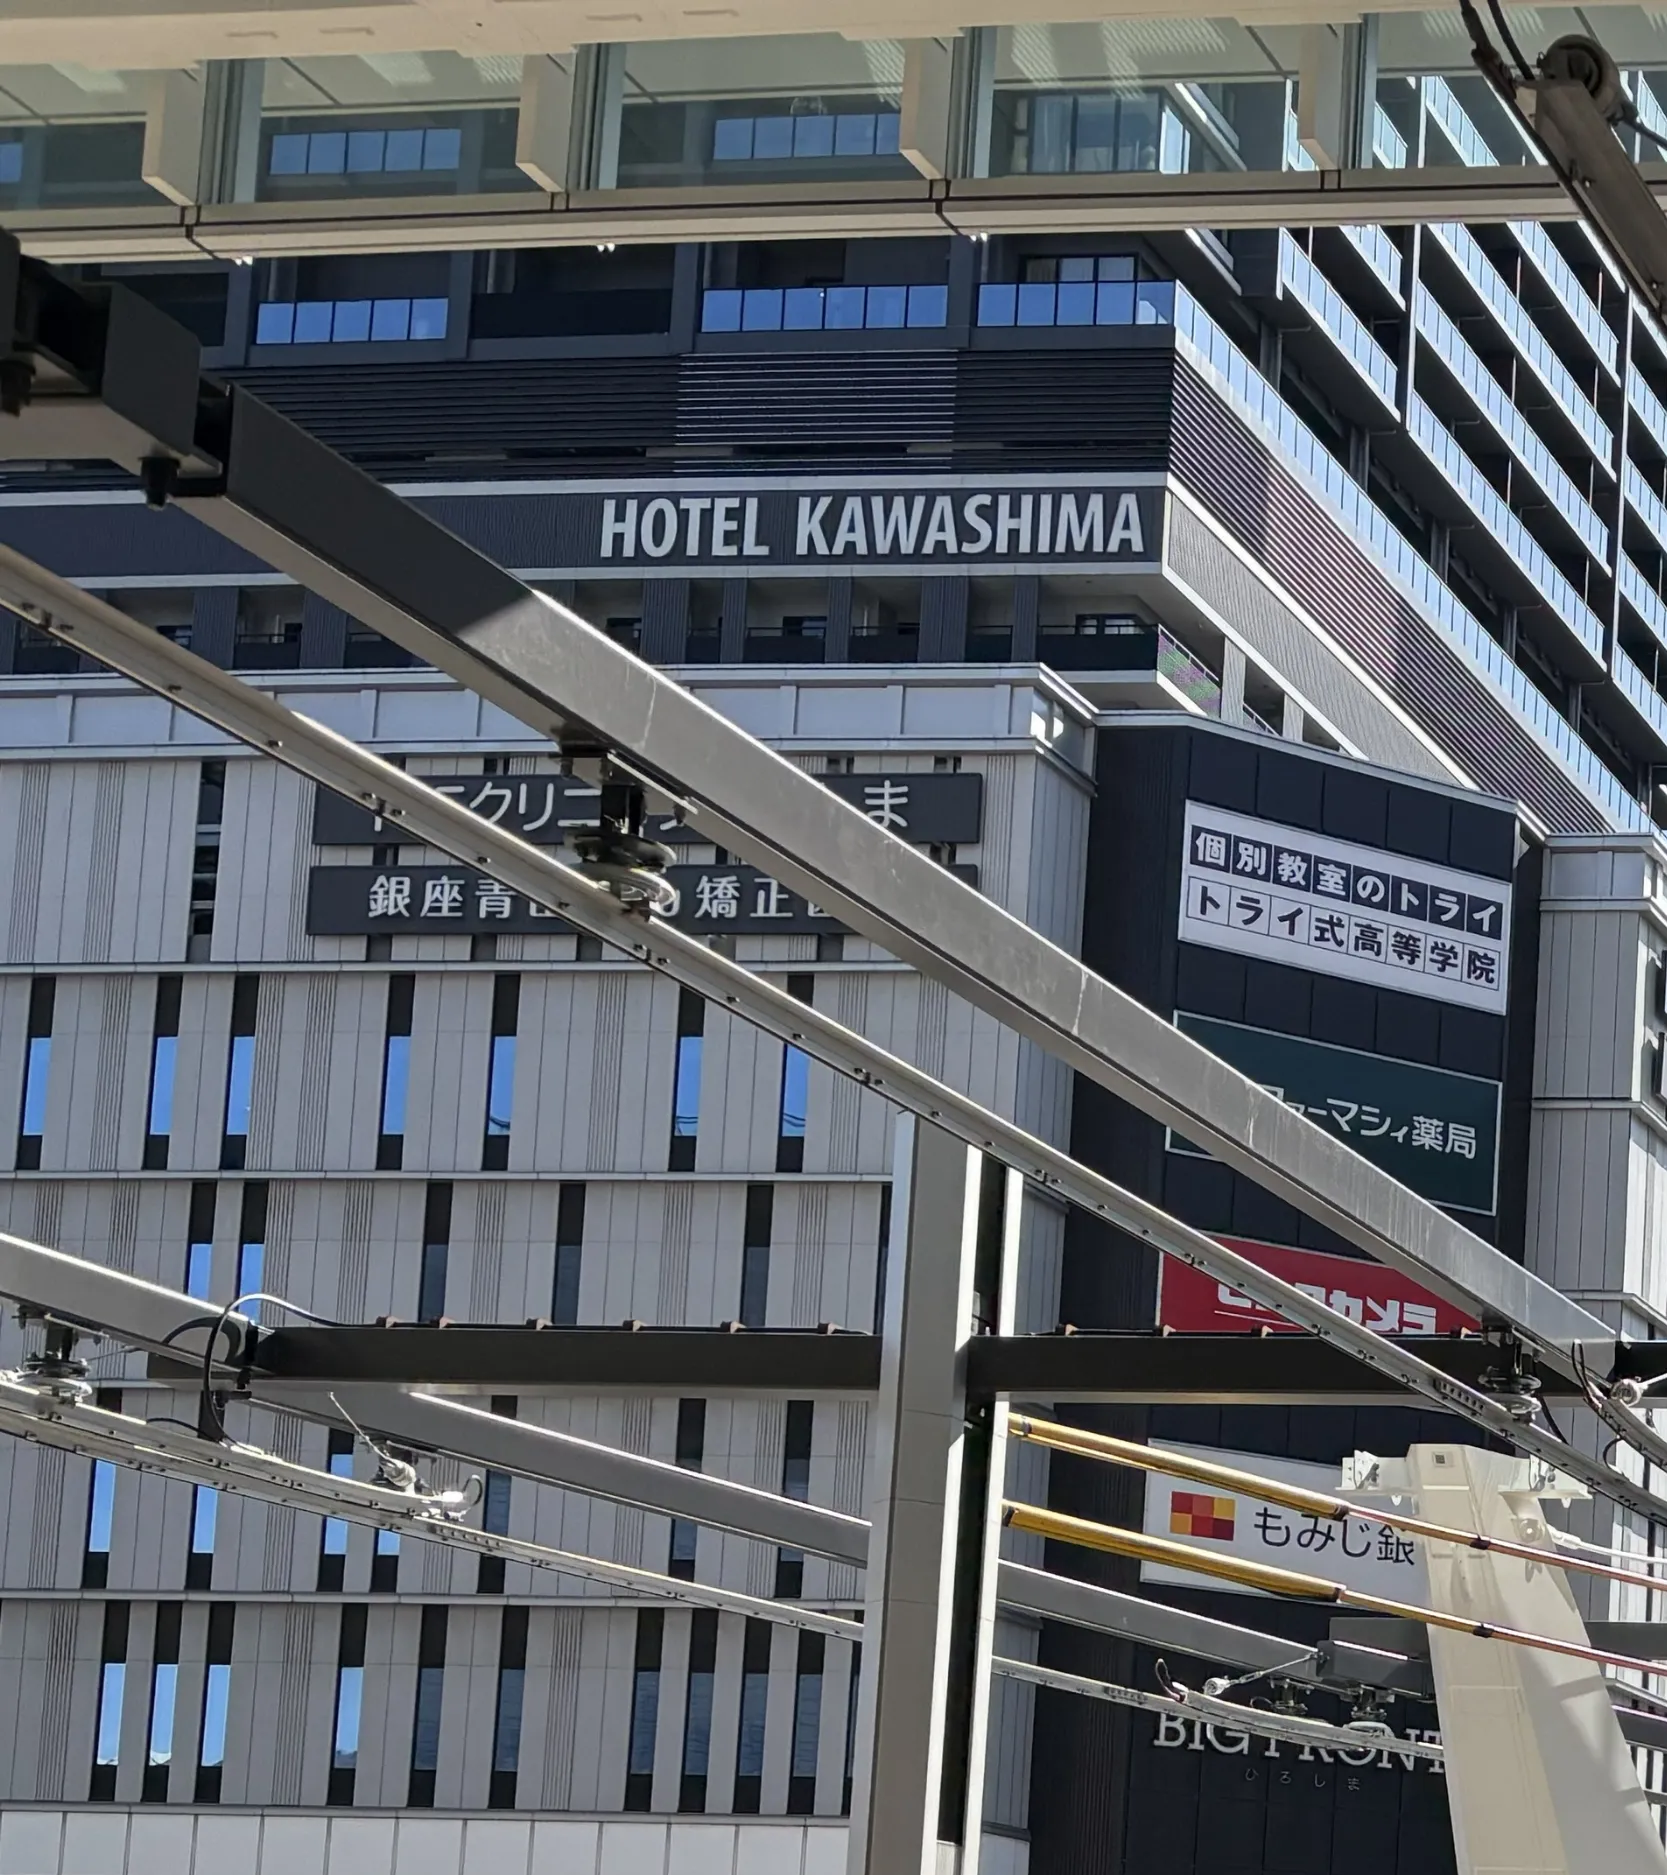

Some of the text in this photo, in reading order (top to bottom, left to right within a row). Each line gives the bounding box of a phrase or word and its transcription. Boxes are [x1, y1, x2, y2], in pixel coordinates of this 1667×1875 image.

[600, 490, 1144, 559] HOTEL KAWASHIMA
[1195, 830, 1502, 934] 個別教室のトライ
[1194, 881, 1498, 985] トライ式高等学院
[1245, 1767, 1360, 1792] ひろしま
